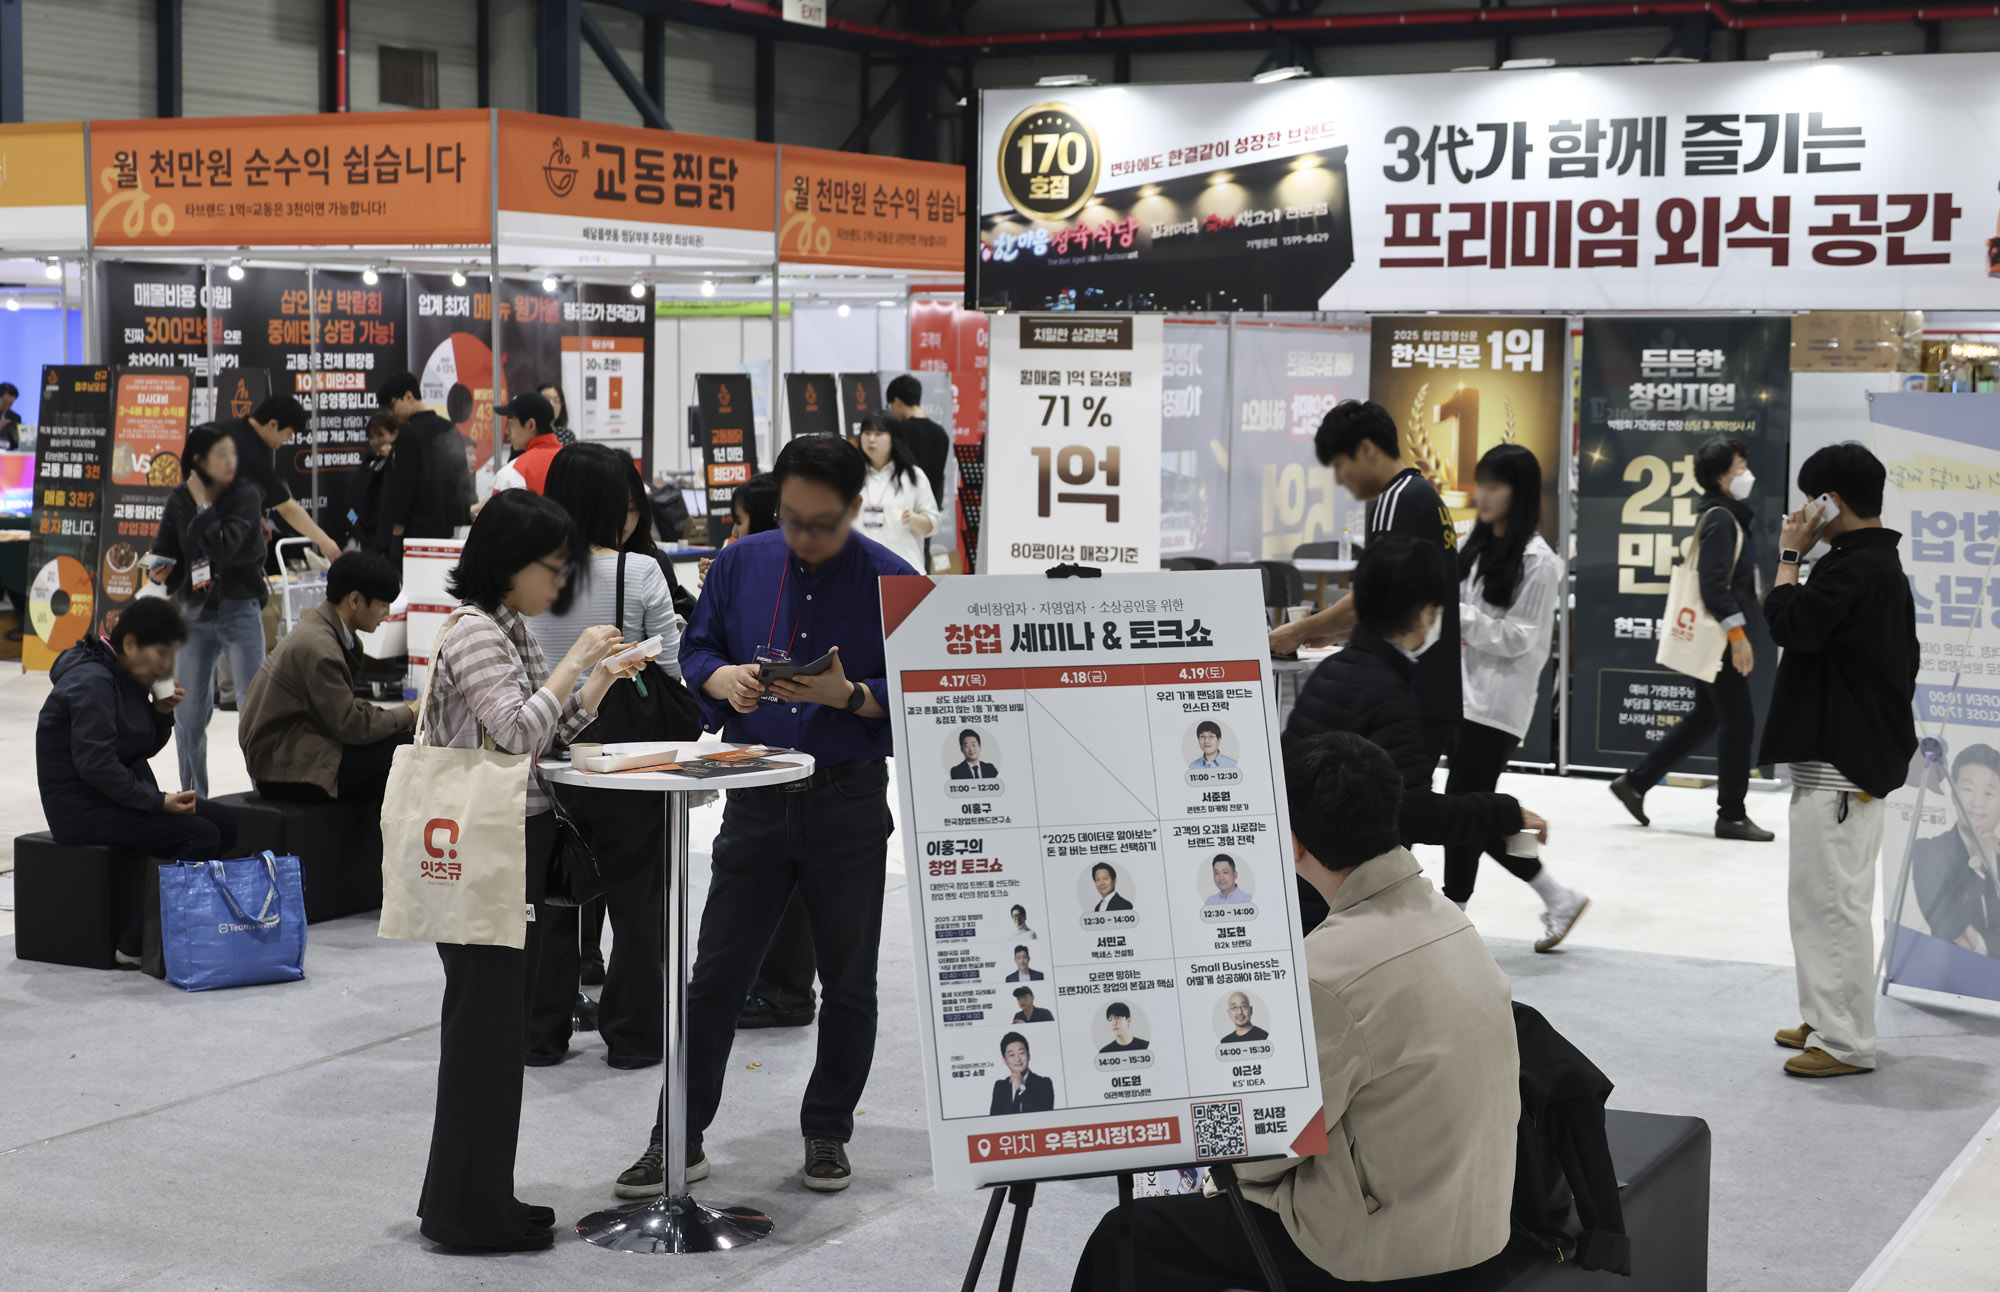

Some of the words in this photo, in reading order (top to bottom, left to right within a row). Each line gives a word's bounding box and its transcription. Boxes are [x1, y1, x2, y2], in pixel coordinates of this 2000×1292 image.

[801, 4, 822, 20] EXIT
[1017, 131, 1087, 176] 170
[1110, 154, 1164, 177] 변화에도
[1168, 139, 1230, 167] 한결같이
[1235, 131, 1282, 154] 성장한
[1288, 120, 1336, 145] 브랜드
[1382, 121, 1533, 185] 3代가
[1548, 116, 1667, 179] 함께
[1681, 112, 1866, 176] 즐기는
[113, 150, 139, 189] 월
[149, 148, 233, 188] 천만원
[244, 145, 330, 187] 순수익
[343, 142, 467, 185] 쉽습니다
[593, 143, 739, 211] 교동찜닭
[1029, 175, 1069, 200] 호점
[793, 175, 810, 211] 월
[816, 177, 867, 215] 천만원
[872, 184, 920, 221] 순수익
[185, 203, 226, 217] 타브랜드
[286, 201, 325, 216] 3천이면
[328, 200, 387, 215] 가능합니다!
[1285, 202, 1329, 221] 전문점
[1379, 198, 1640, 269] 프리미엄
[1655, 195, 1791, 267] 외식
[1808, 192, 1962, 266] 공간
[134, 283, 196, 308] 매몰비용
[336, 290, 383, 315] 박람회
[418, 293, 443, 316] 업계
[445, 294, 470, 317] 최저
[606, 303, 646, 323] 전격공개
[324, 319, 356, 344] 상담
[359, 321, 394, 345] 가능!
[1034, 327, 1069, 343] 치밀한
[1071, 327, 1119, 343] 상권분석
[1393, 330, 1419, 341] 2025
[1422, 330, 1479, 342] 창업경영신문
[1391, 343, 1482, 369] 한식부문
[1487, 328, 1545, 372] 1위
[323, 352, 344, 369] 전체
[345, 352, 375, 370] 매장중
[1640, 348, 1726, 378] 든든한
[325, 372, 366, 390] 미만으로
[1020, 369, 1062, 386] 월매출
[1066, 370, 1085, 387] 1억
[1090, 370, 1133, 387] 달성률
[1628, 382, 1736, 412] 창업지원
[40, 462, 61, 478] 교동
[62, 463, 83, 479] 매출
[131, 453, 151, 474] VS
[713, 465, 746, 482] 최단기간
[1031, 444, 1121, 523] 1억
[1010, 542, 1075, 562] 80평이상
[1080, 545, 1139, 564] 매장기준
[967, 602, 1027, 617] 예비창업자
[1039, 600, 1087, 615] 자영업자
[1099, 598, 1157, 613] 소상공인을
[1161, 598, 1184, 612] 위한
[1614, 616, 1654, 639] 현금
[945, 623, 1003, 655] 창업
[1010, 621, 1095, 653] 세미나
[1102, 620, 1122, 650] &
[1129, 618, 1213, 649] 토크쇼
[939, 673, 987, 688] 4.17(목)
[1060, 670, 1107, 684] 4.18(금)
[1178, 666, 1226, 680] 4.19(토)
[936, 695, 951, 704] 상도
[953, 694, 975, 704] 상실의
[1156, 691, 1175, 701] 우리
[1176, 690, 1196, 700] 가게
[1196, 689, 1224, 700] 팬덤을
[1226, 688, 1253, 698] 만드는
[1009, 702, 1025, 712] 비밀
[1182, 702, 1210, 713] 인스타
[1211, 701, 1230, 712] 전략
[984, 713, 999, 723] 정석
[1190, 773, 1209, 782] 11:00
[1217, 772, 1238, 781] 12:30
[978, 783, 1000, 792] 12:00
[1202, 791, 1231, 802] 서준원
[961, 803, 993, 815] 이홍구
[1229, 803, 1249, 812] 전문가
[1077, 831, 1115, 843] 데이터로
[1172, 825, 1201, 836] 고객의
[1202, 823, 1229, 835] 오감을
[1231, 821, 1267, 833] 사로잡는
[926, 838, 984, 856] 이홍구의
[1047, 846, 1056, 857] 돈
[1058, 846, 1068, 856] 잘
[1069, 846, 1088, 855] 버는
[1090, 843, 1118, 854] 브랜드
[1119, 841, 1157, 853] 선택하기
[1187, 838, 1215, 848] 브랜드
[1217, 836, 1235, 847] 경험
[1237, 834, 1255, 845] 전략
[420, 860, 462, 881] 잇츠큐
[929, 859, 957, 876] 창업
[961, 857, 1003, 875] 토크쇼
[1083, 916, 1105, 925] 12:30
[1113, 914, 1135, 923] 14:00
[1204, 909, 1225, 918] 12:30
[1233, 907, 1255, 916] 14:00
[1217, 926, 1246, 938] 김도현
[1097, 936, 1127, 947] 서민교
[1214, 941, 1230, 950] B2k
[1231, 939, 1252, 949] 브랜딩
[1190, 962, 1221, 974] Small
[1222, 957, 1280, 971] Business는
[1089, 972, 1114, 982] 모르면
[1116, 970, 1141, 980] 망하는
[1186, 975, 1214, 987] 어떻게
[1216, 972, 1252, 985] 성공해야
[1254, 969, 1287, 982] 하는가?
[1058, 984, 1101, 997] 프랜차이즈
[1102, 982, 1128, 993] 창업의
[1129, 980, 1155, 991] 본질과
[1157, 978, 1175, 989] 핵심
[1219, 1047, 1242, 1057] 14:00
[1248, 1045, 1271, 1054] 15:30
[1098, 1057, 1121, 1066] 14:00
[1129, 1055, 1151, 1064] 15:30
[1232, 1064, 1262, 1077] 이근상
[1111, 1075, 1141, 1087] 이도원
[1246, 1077, 1266, 1087] IDEA
[1252, 1106, 1287, 1121] 전시장
[1254, 1121, 1288, 1135] 배치도
[999, 1133, 1036, 1155] 위치
[1045, 1121, 1171, 1151] 우측전시장[3관]
